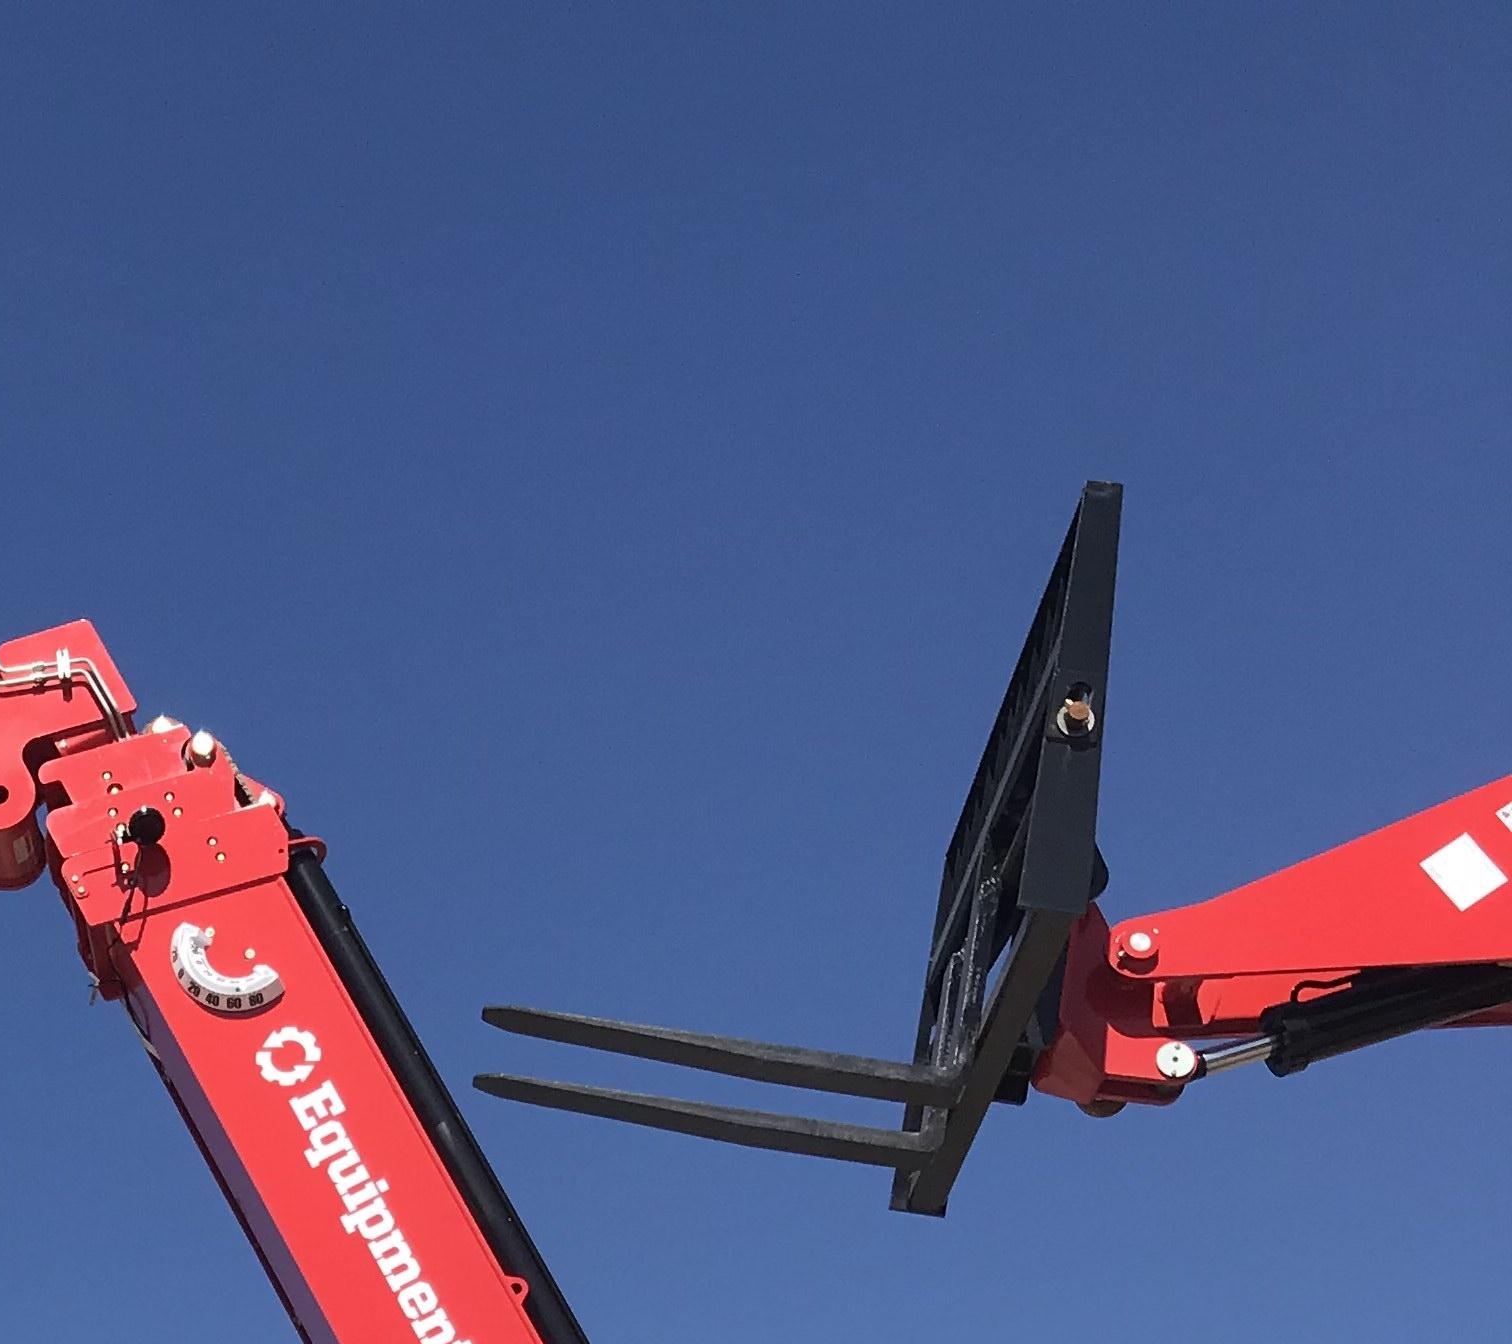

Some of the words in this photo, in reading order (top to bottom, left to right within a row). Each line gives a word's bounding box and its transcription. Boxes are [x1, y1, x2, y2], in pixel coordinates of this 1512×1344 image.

[205, 993, 220, 1007] 40
[226, 997, 242, 1009] 60
[248, 992, 264, 1006] 80
